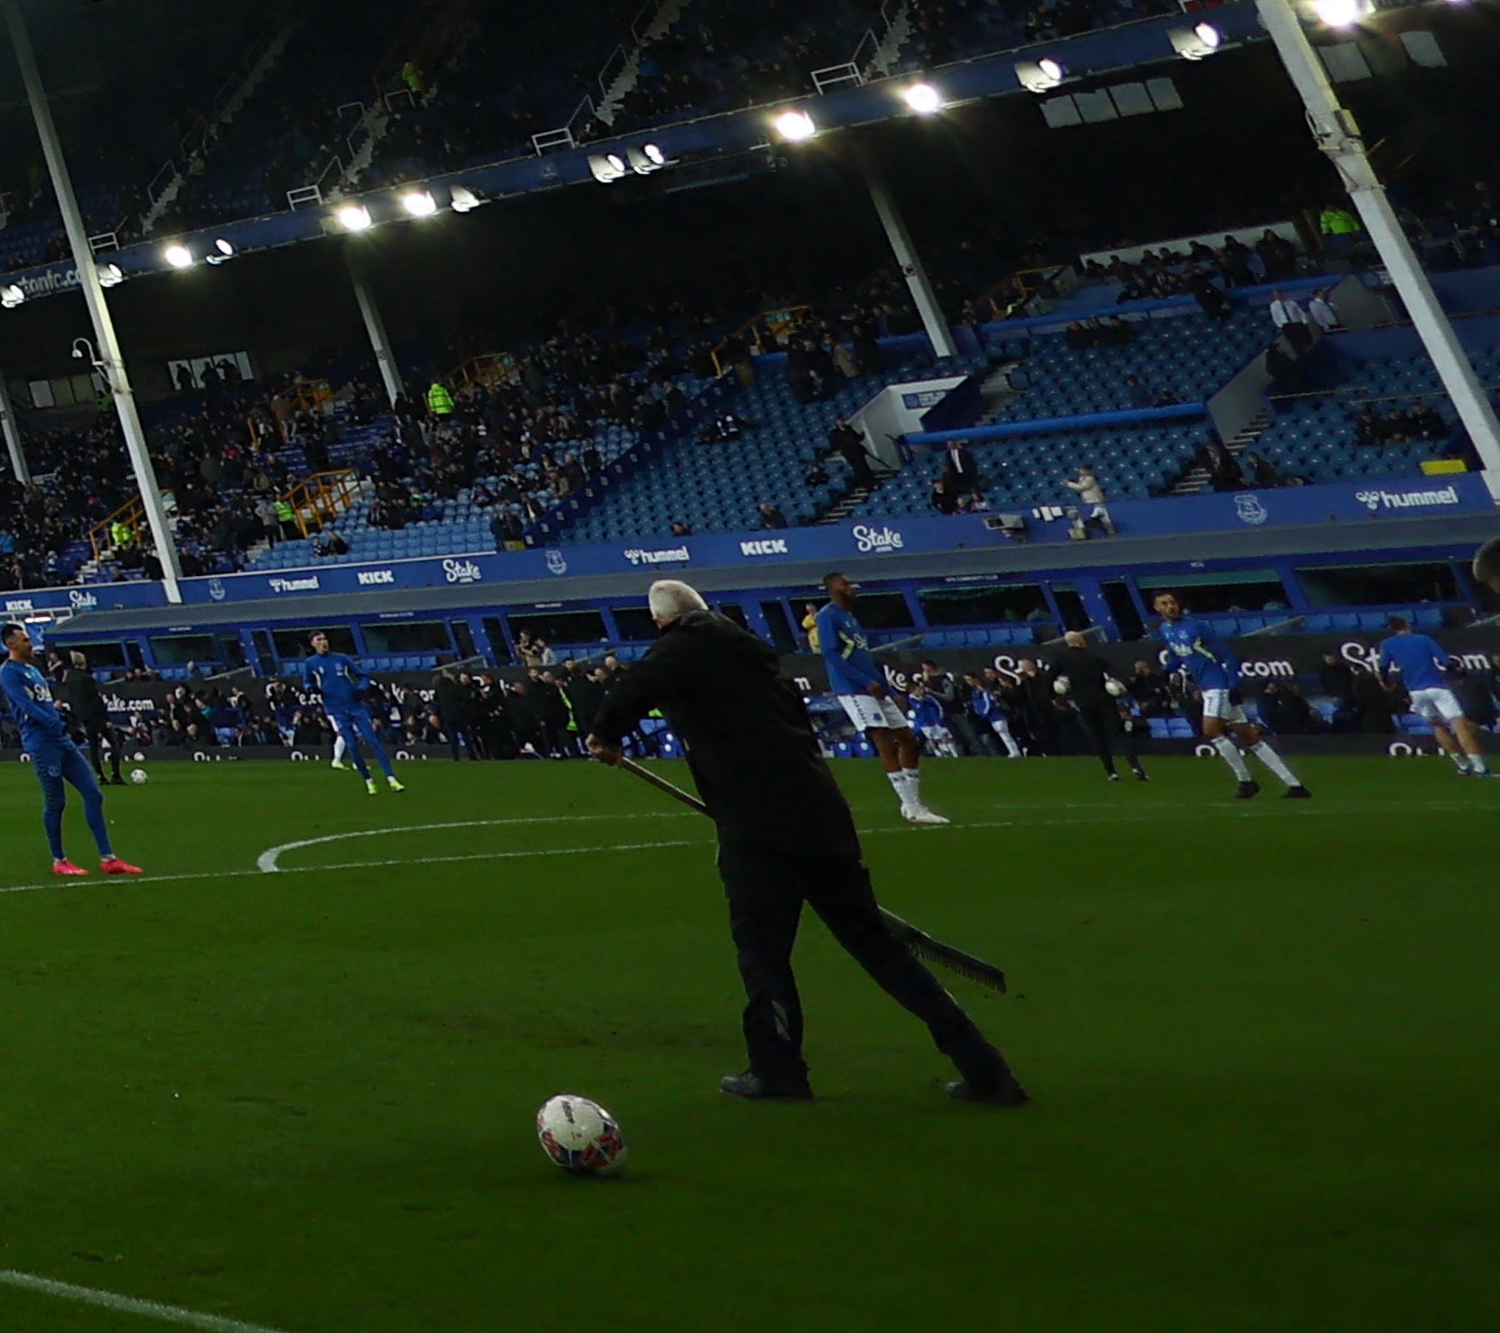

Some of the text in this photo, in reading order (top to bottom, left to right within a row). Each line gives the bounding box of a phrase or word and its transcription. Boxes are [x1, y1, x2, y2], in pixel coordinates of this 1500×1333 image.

[1380, 485, 1459, 509] hummel
[739, 539, 788, 557] KICK
[853, 524, 905, 553] Stake
[641, 545, 690, 564] hummel
[357, 569, 395, 585] KICK
